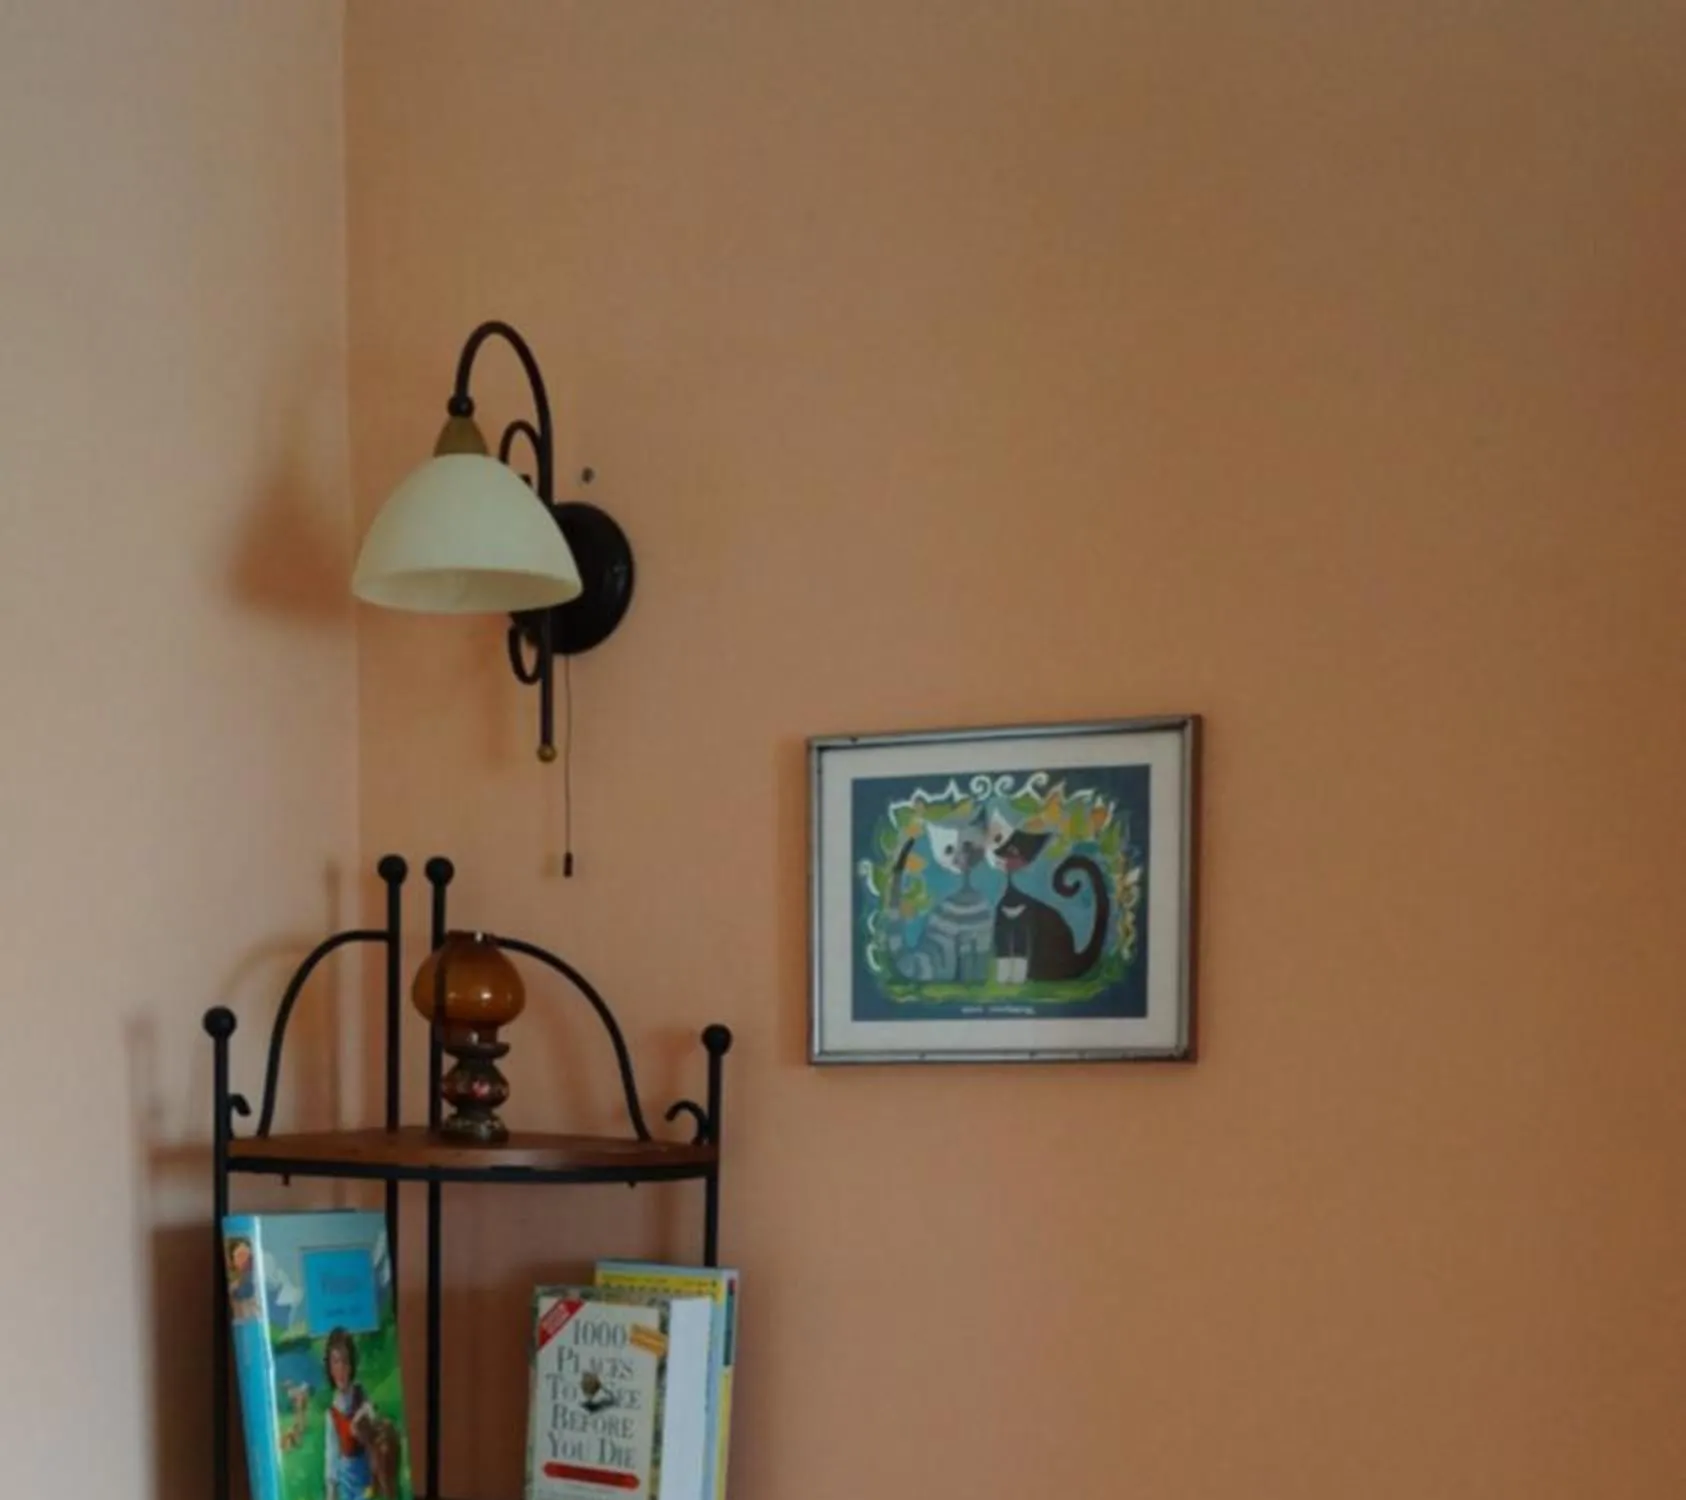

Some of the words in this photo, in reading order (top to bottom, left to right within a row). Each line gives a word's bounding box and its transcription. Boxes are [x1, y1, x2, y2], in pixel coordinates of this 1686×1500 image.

[573, 1318, 627, 1347] 1000
[545, 1373, 578, 1401] TO
[551, 1403, 636, 1439] BEFORE
[547, 1431, 588, 1461] YOU
[598, 1438, 637, 1470] DIE
